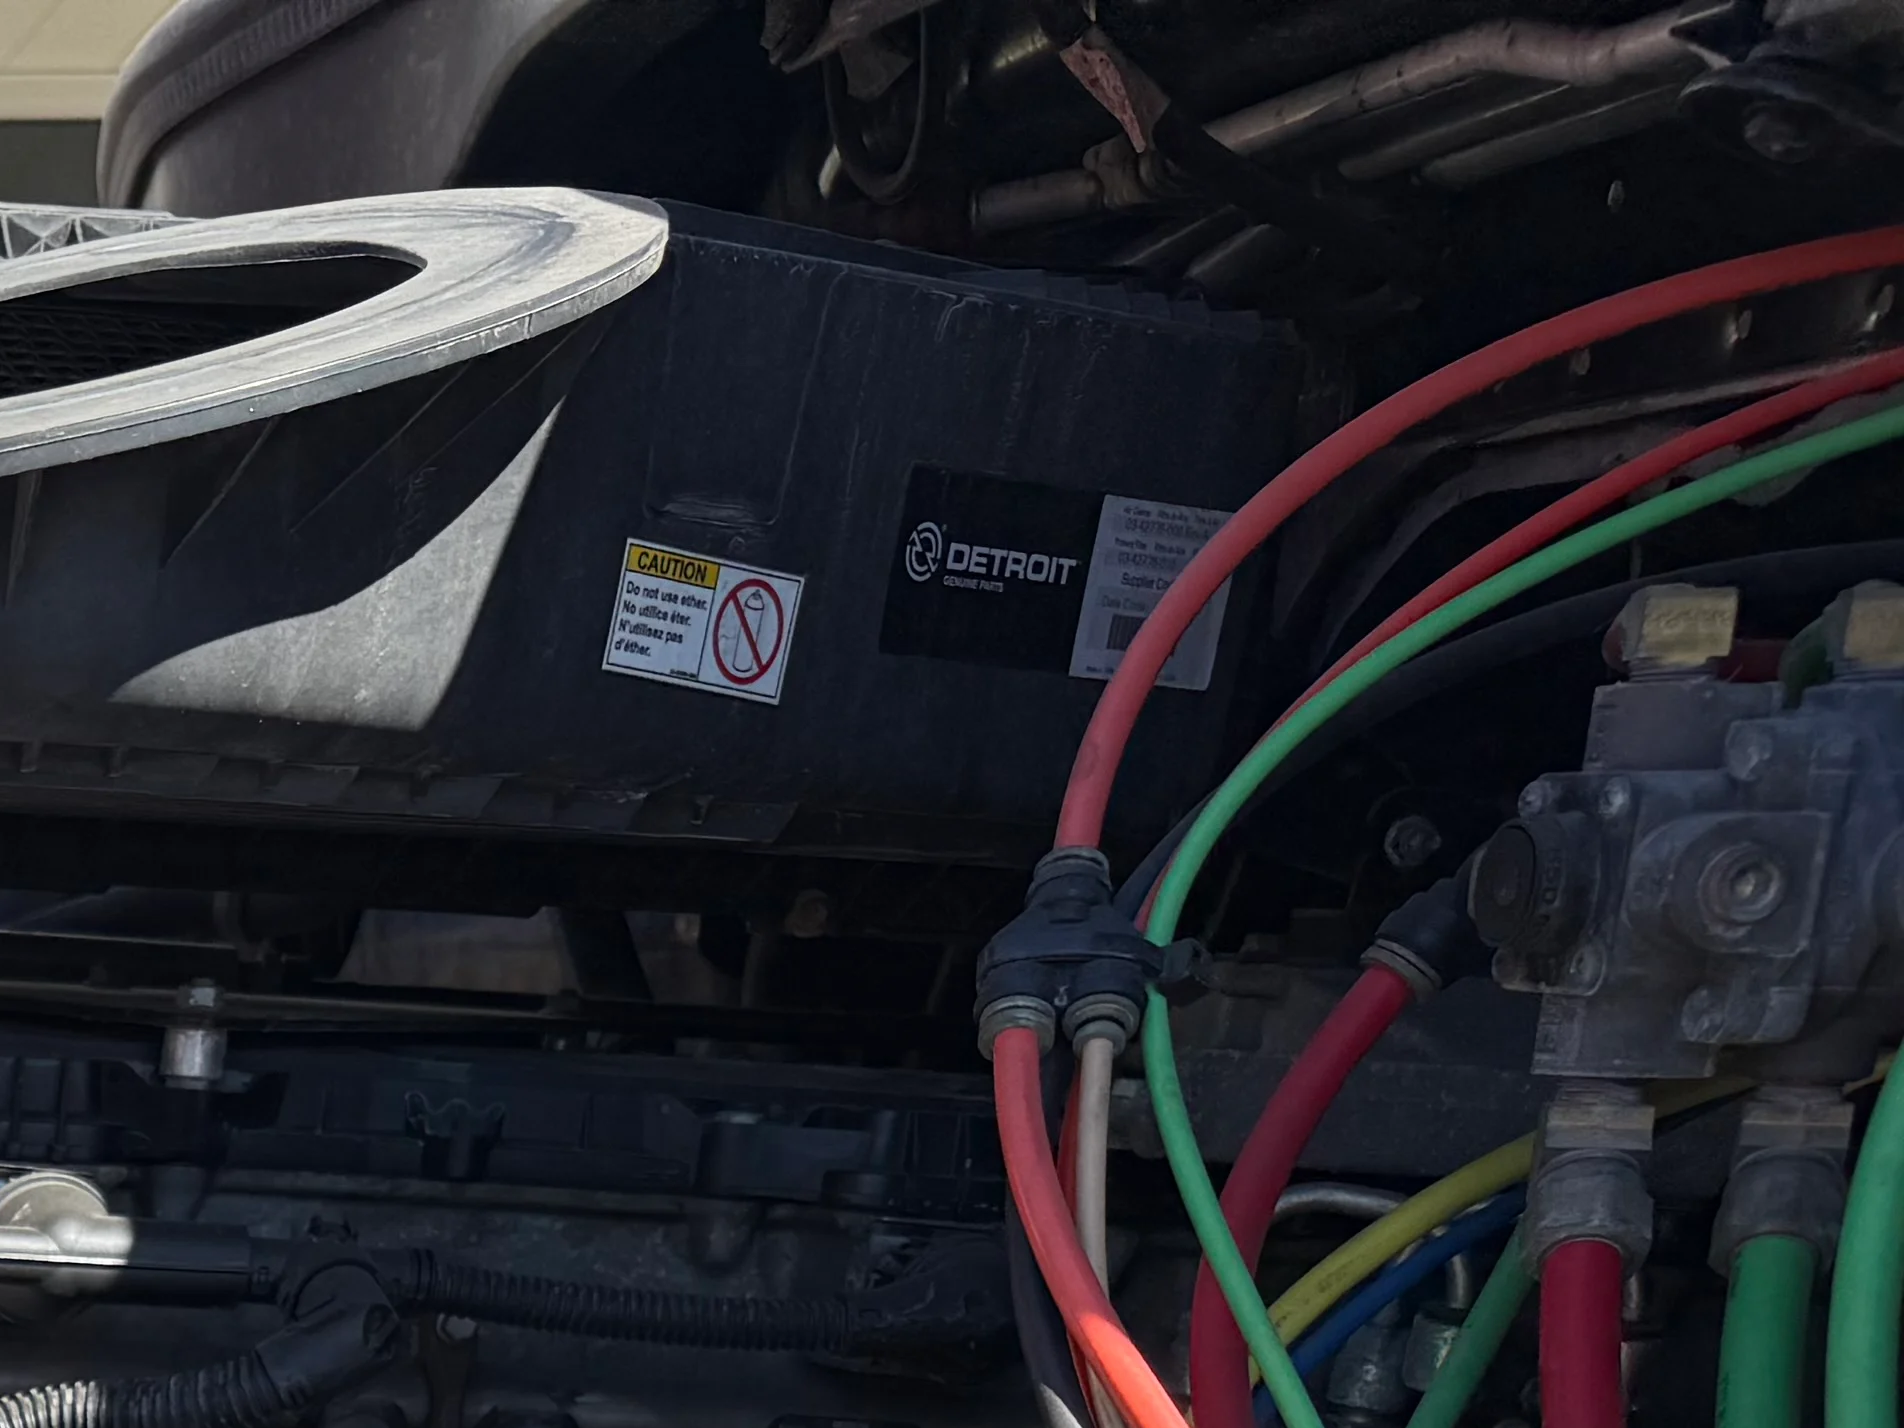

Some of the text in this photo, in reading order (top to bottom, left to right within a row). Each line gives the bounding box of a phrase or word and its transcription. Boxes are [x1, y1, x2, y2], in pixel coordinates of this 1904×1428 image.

[638, 551, 708, 584] CAUTION
[946, 542, 1077, 585] DETROIT
[626, 580, 639, 596] Do
[642, 584, 659, 599] not
[661, 590, 679, 604] use
[943, 575, 1004, 593] GENUINE PARTS
[622, 600, 637, 615] No
[665, 631, 683, 645] pas
